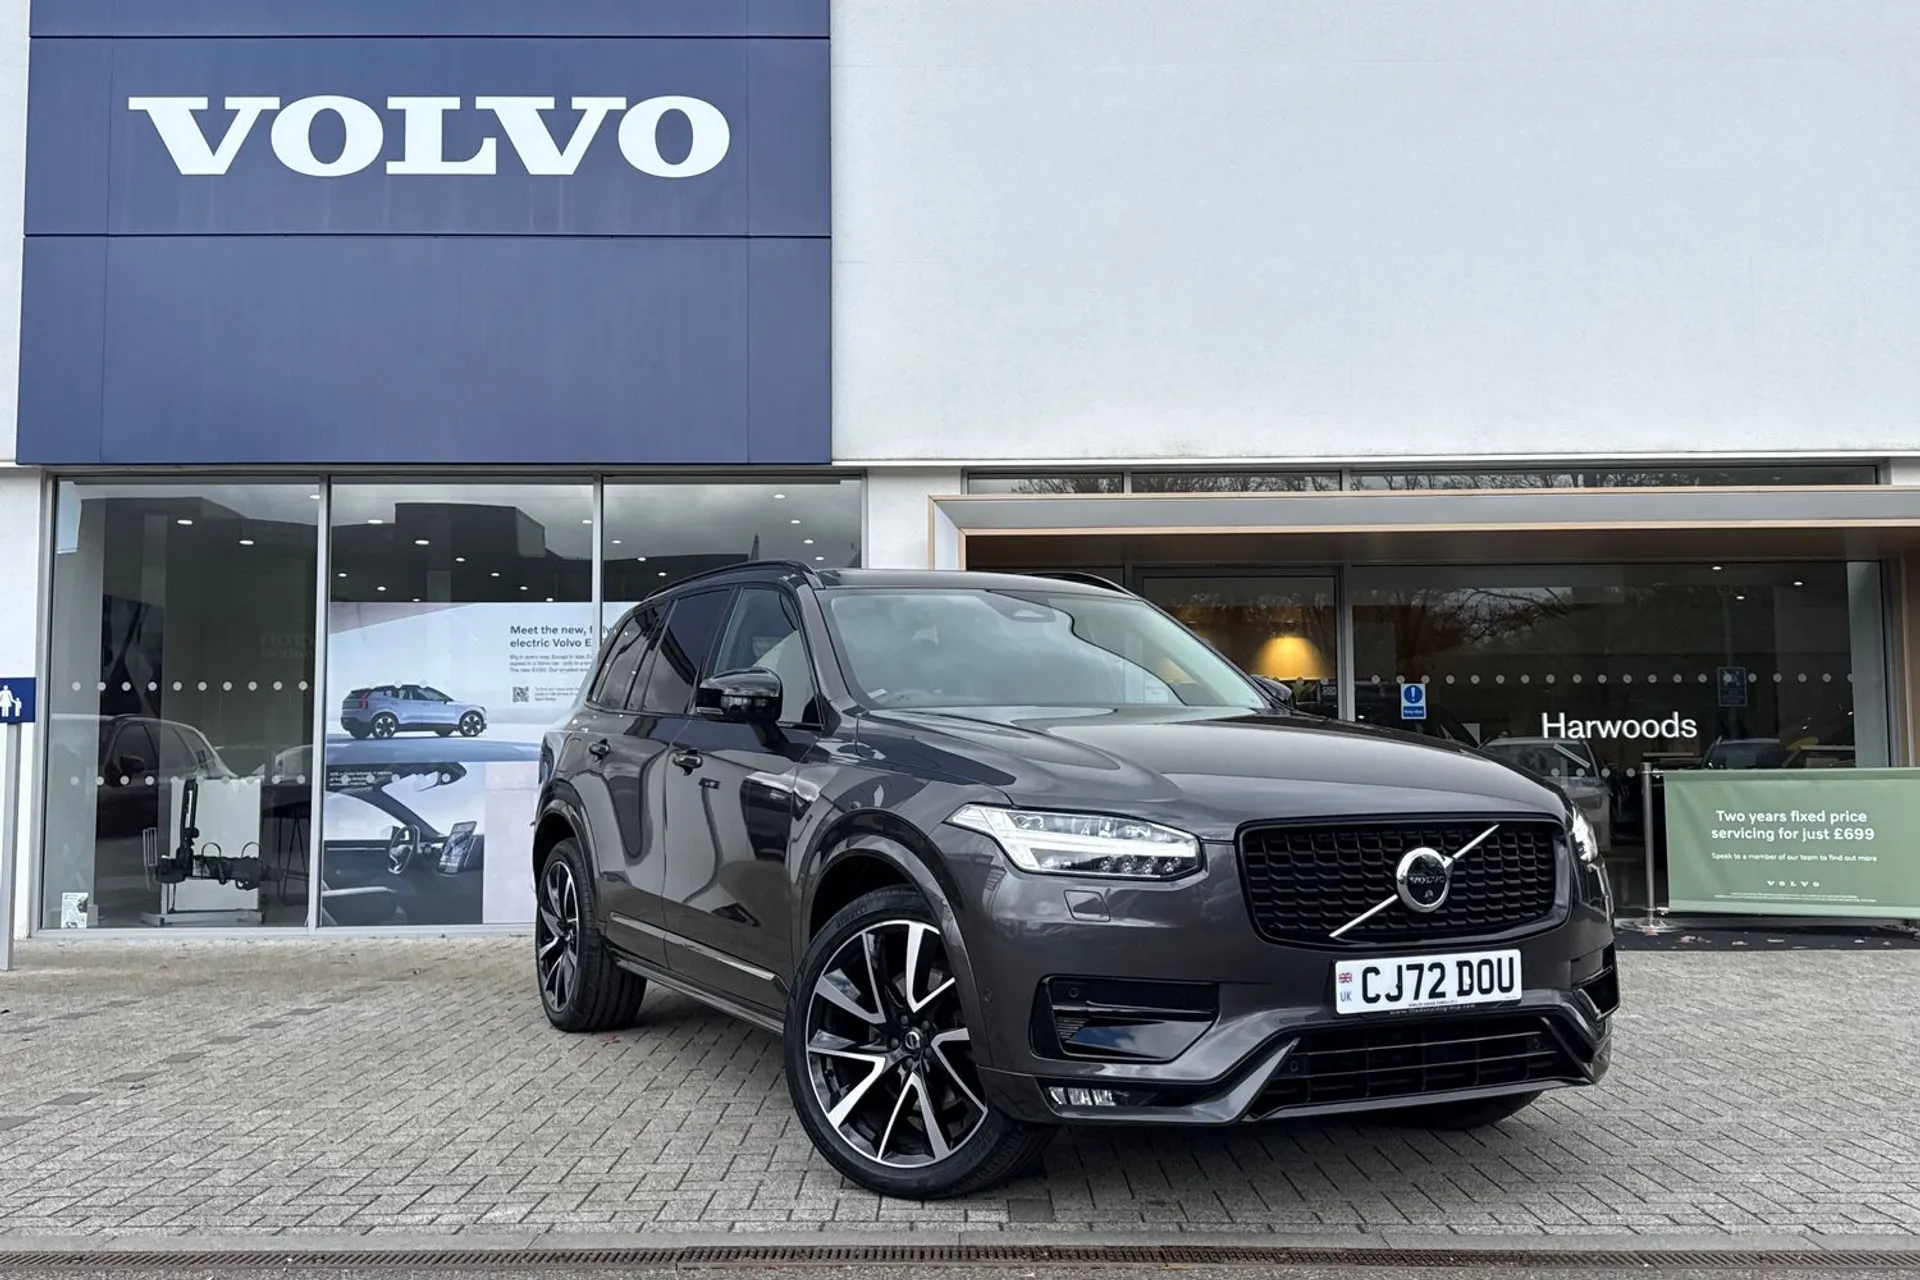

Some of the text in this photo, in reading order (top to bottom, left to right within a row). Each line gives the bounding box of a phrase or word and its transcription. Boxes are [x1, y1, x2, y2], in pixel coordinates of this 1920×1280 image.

[128, 95, 730, 178] VOLVO
[510, 625, 538, 634] Meet
[541, 625, 558, 634] the
[561, 627, 586, 636] new,
[510, 638, 550, 647] electric
[552, 638, 581, 647] Volvo
[1540, 711, 1698, 738] Harwoods
[1715, 810, 1868, 825] Two years fixed price
[1711, 828, 1875, 842] servicing for just £699
[1711, 853, 1732, 861] Speak
[1409, 876, 1445, 884] VOLVO
[1362, 957, 1514, 1004] CJ72 DOU
[1340, 991, 1352, 1002] UK
